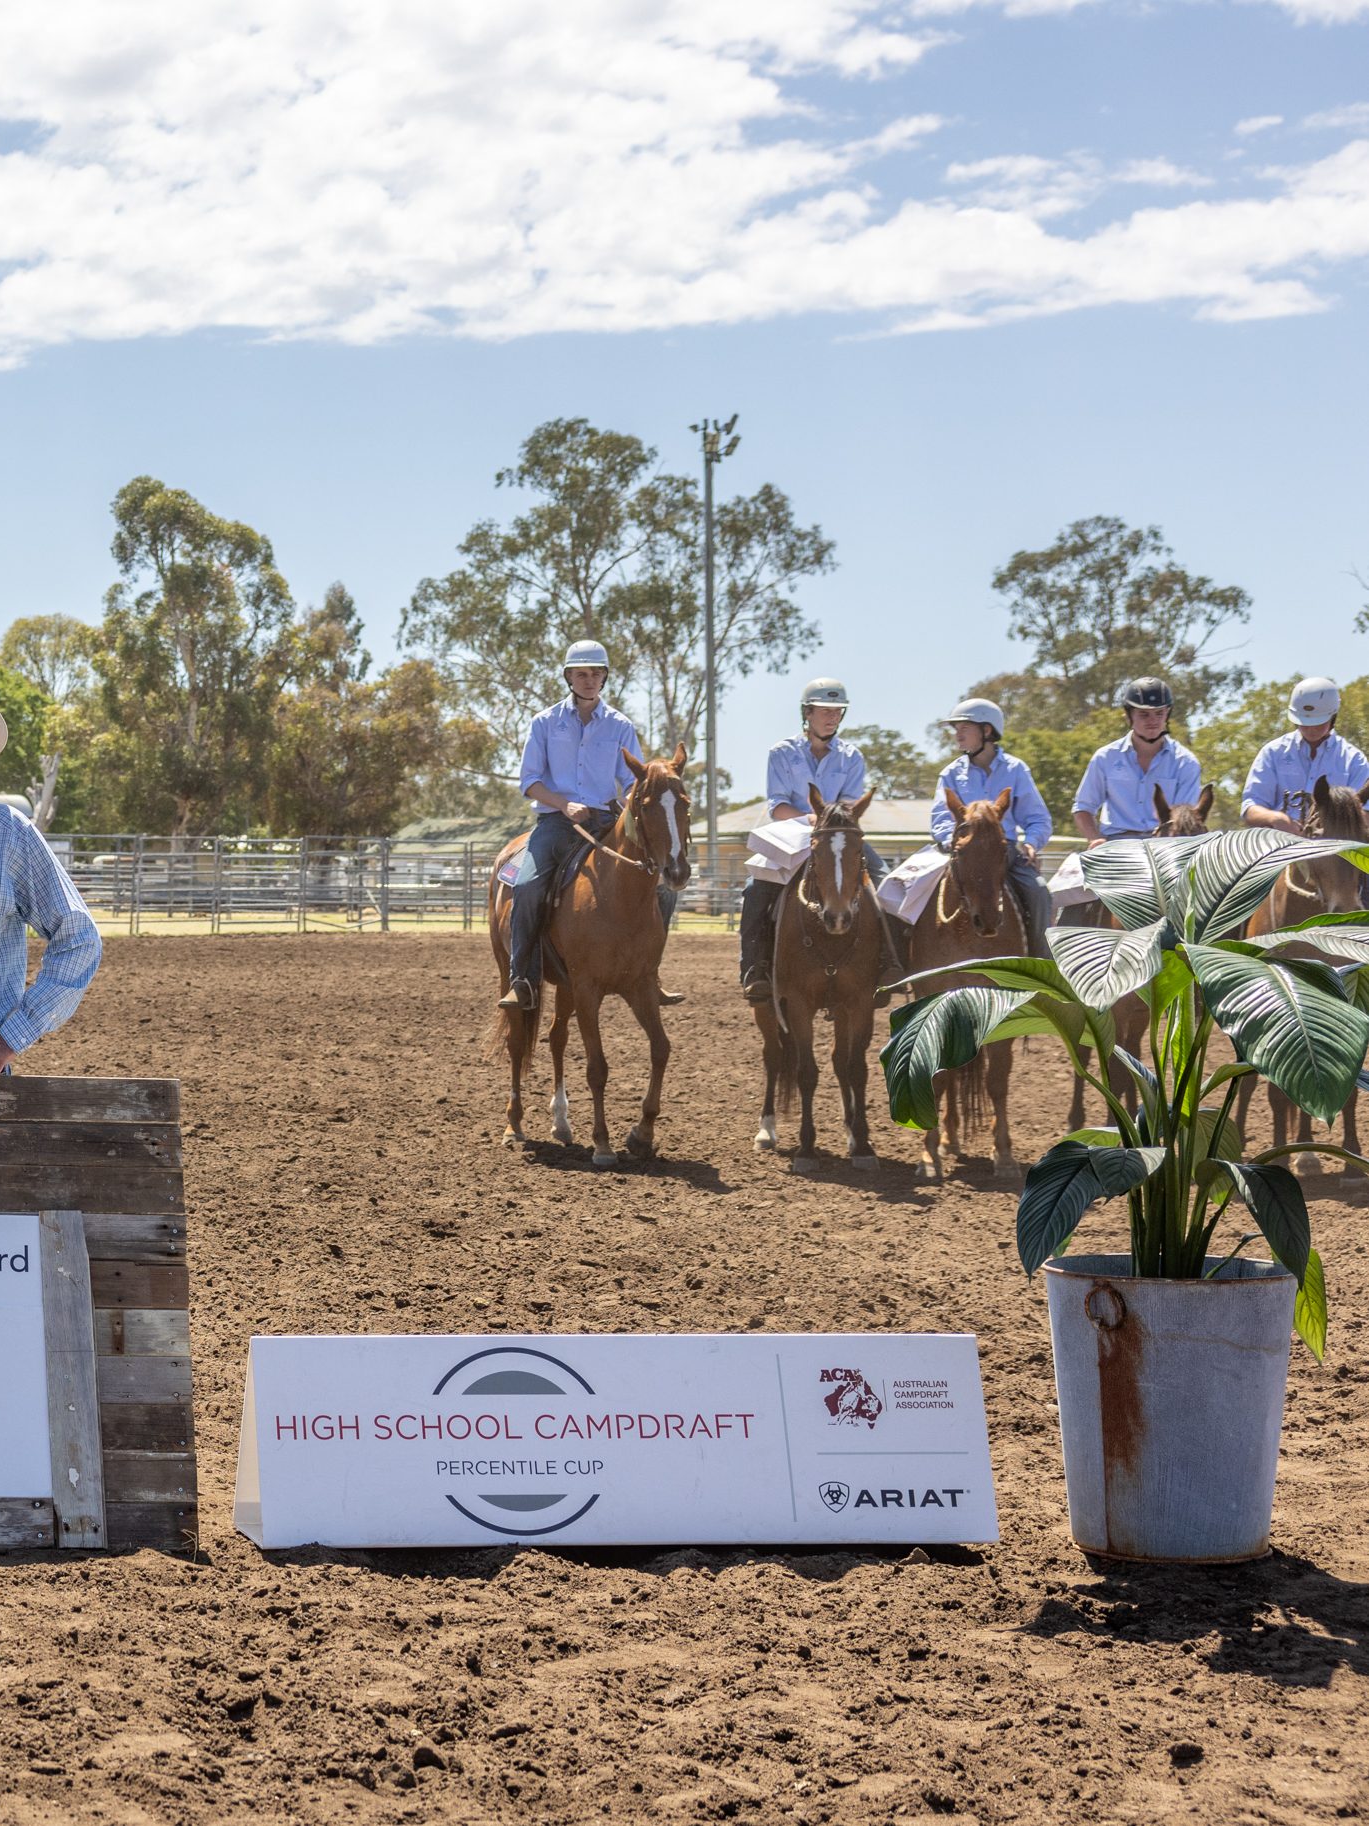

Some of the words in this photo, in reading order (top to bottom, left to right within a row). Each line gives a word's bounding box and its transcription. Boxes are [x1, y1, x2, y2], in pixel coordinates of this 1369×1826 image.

[819, 1367, 856, 1383] ACA
[892, 1380, 948, 1389] AUSTRALIAN
[893, 1390, 949, 1399] CAMPDRAFT
[895, 1400, 954, 1410] ASSOCIATION
[275, 1414, 360, 1441] HIGH
[373, 1414, 523, 1440] SCHOOL
[534, 1413, 755, 1440] CAMPDRAFT
[436, 1460, 558, 1476] PERCENTILE
[563, 1460, 604, 1475] CUP
[853, 1489, 964, 1508] ARIAT
